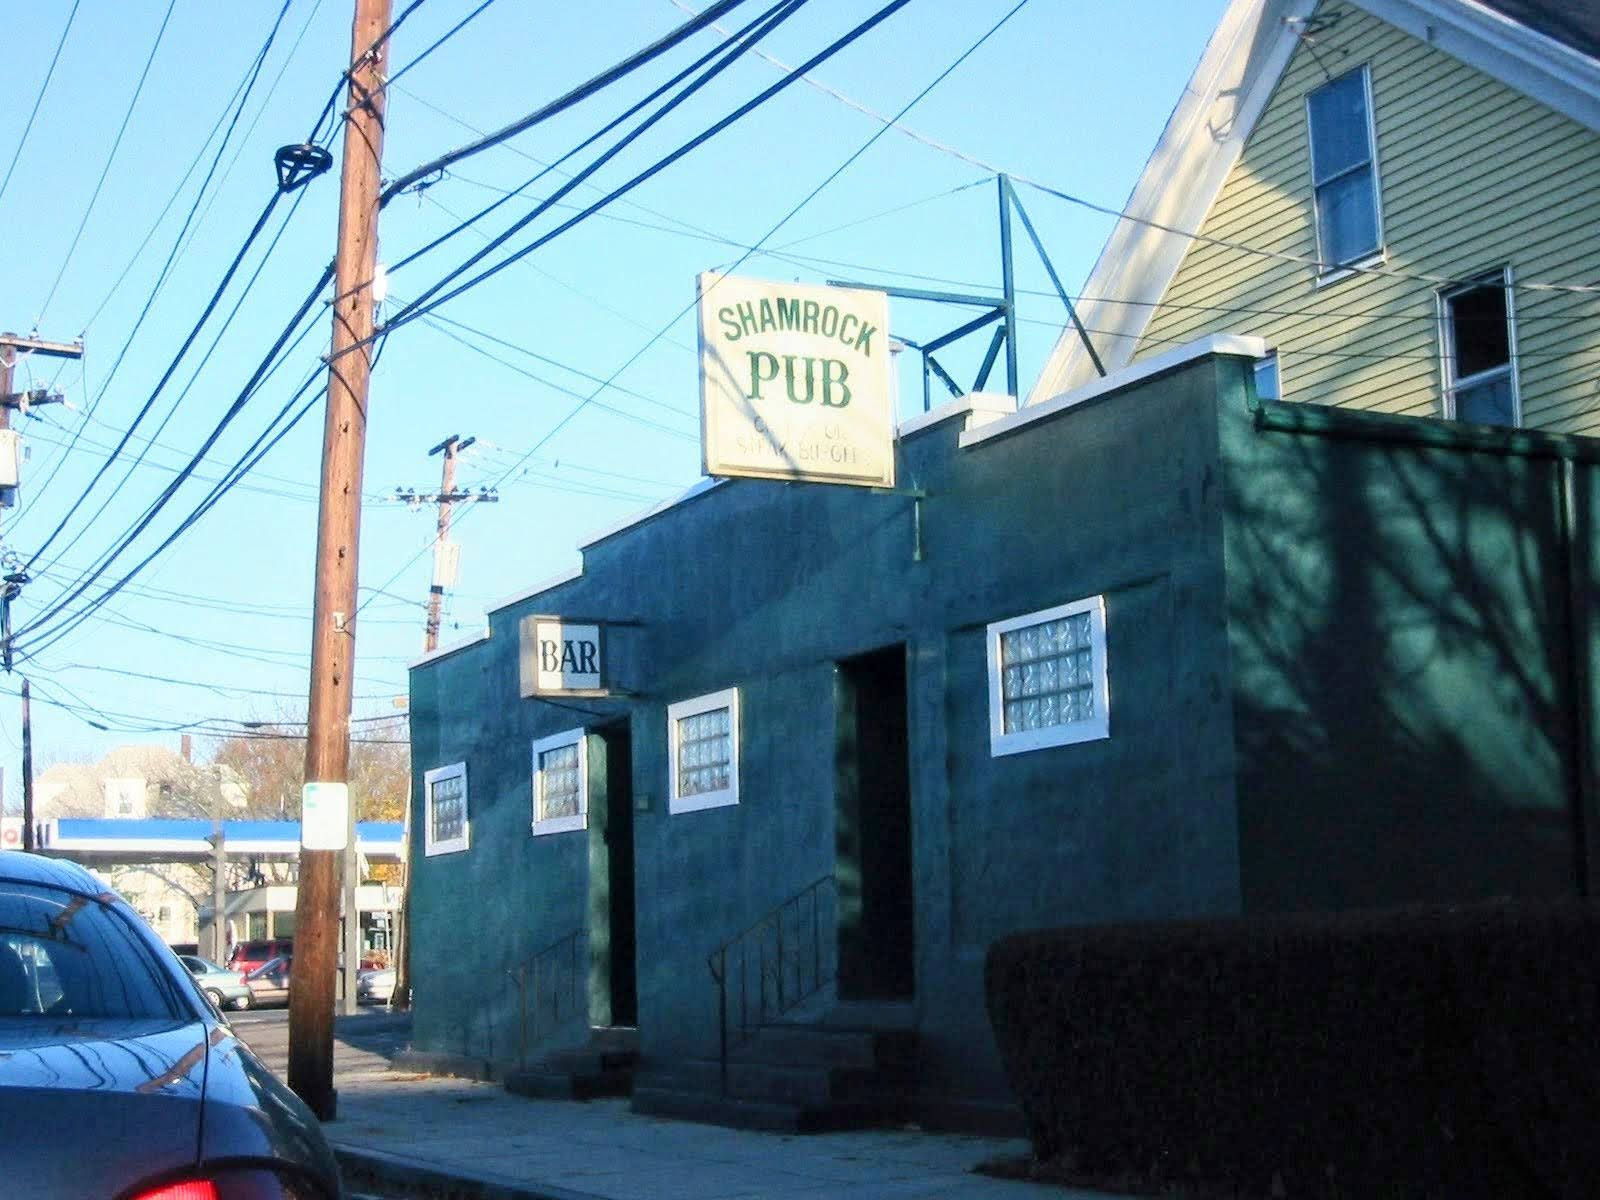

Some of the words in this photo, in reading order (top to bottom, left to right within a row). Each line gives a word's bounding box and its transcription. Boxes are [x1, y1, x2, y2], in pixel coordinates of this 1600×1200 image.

[718, 297, 878, 358] SHAMROCK
[745, 351, 853, 409] PUB
[540, 639, 600, 674] BAR
